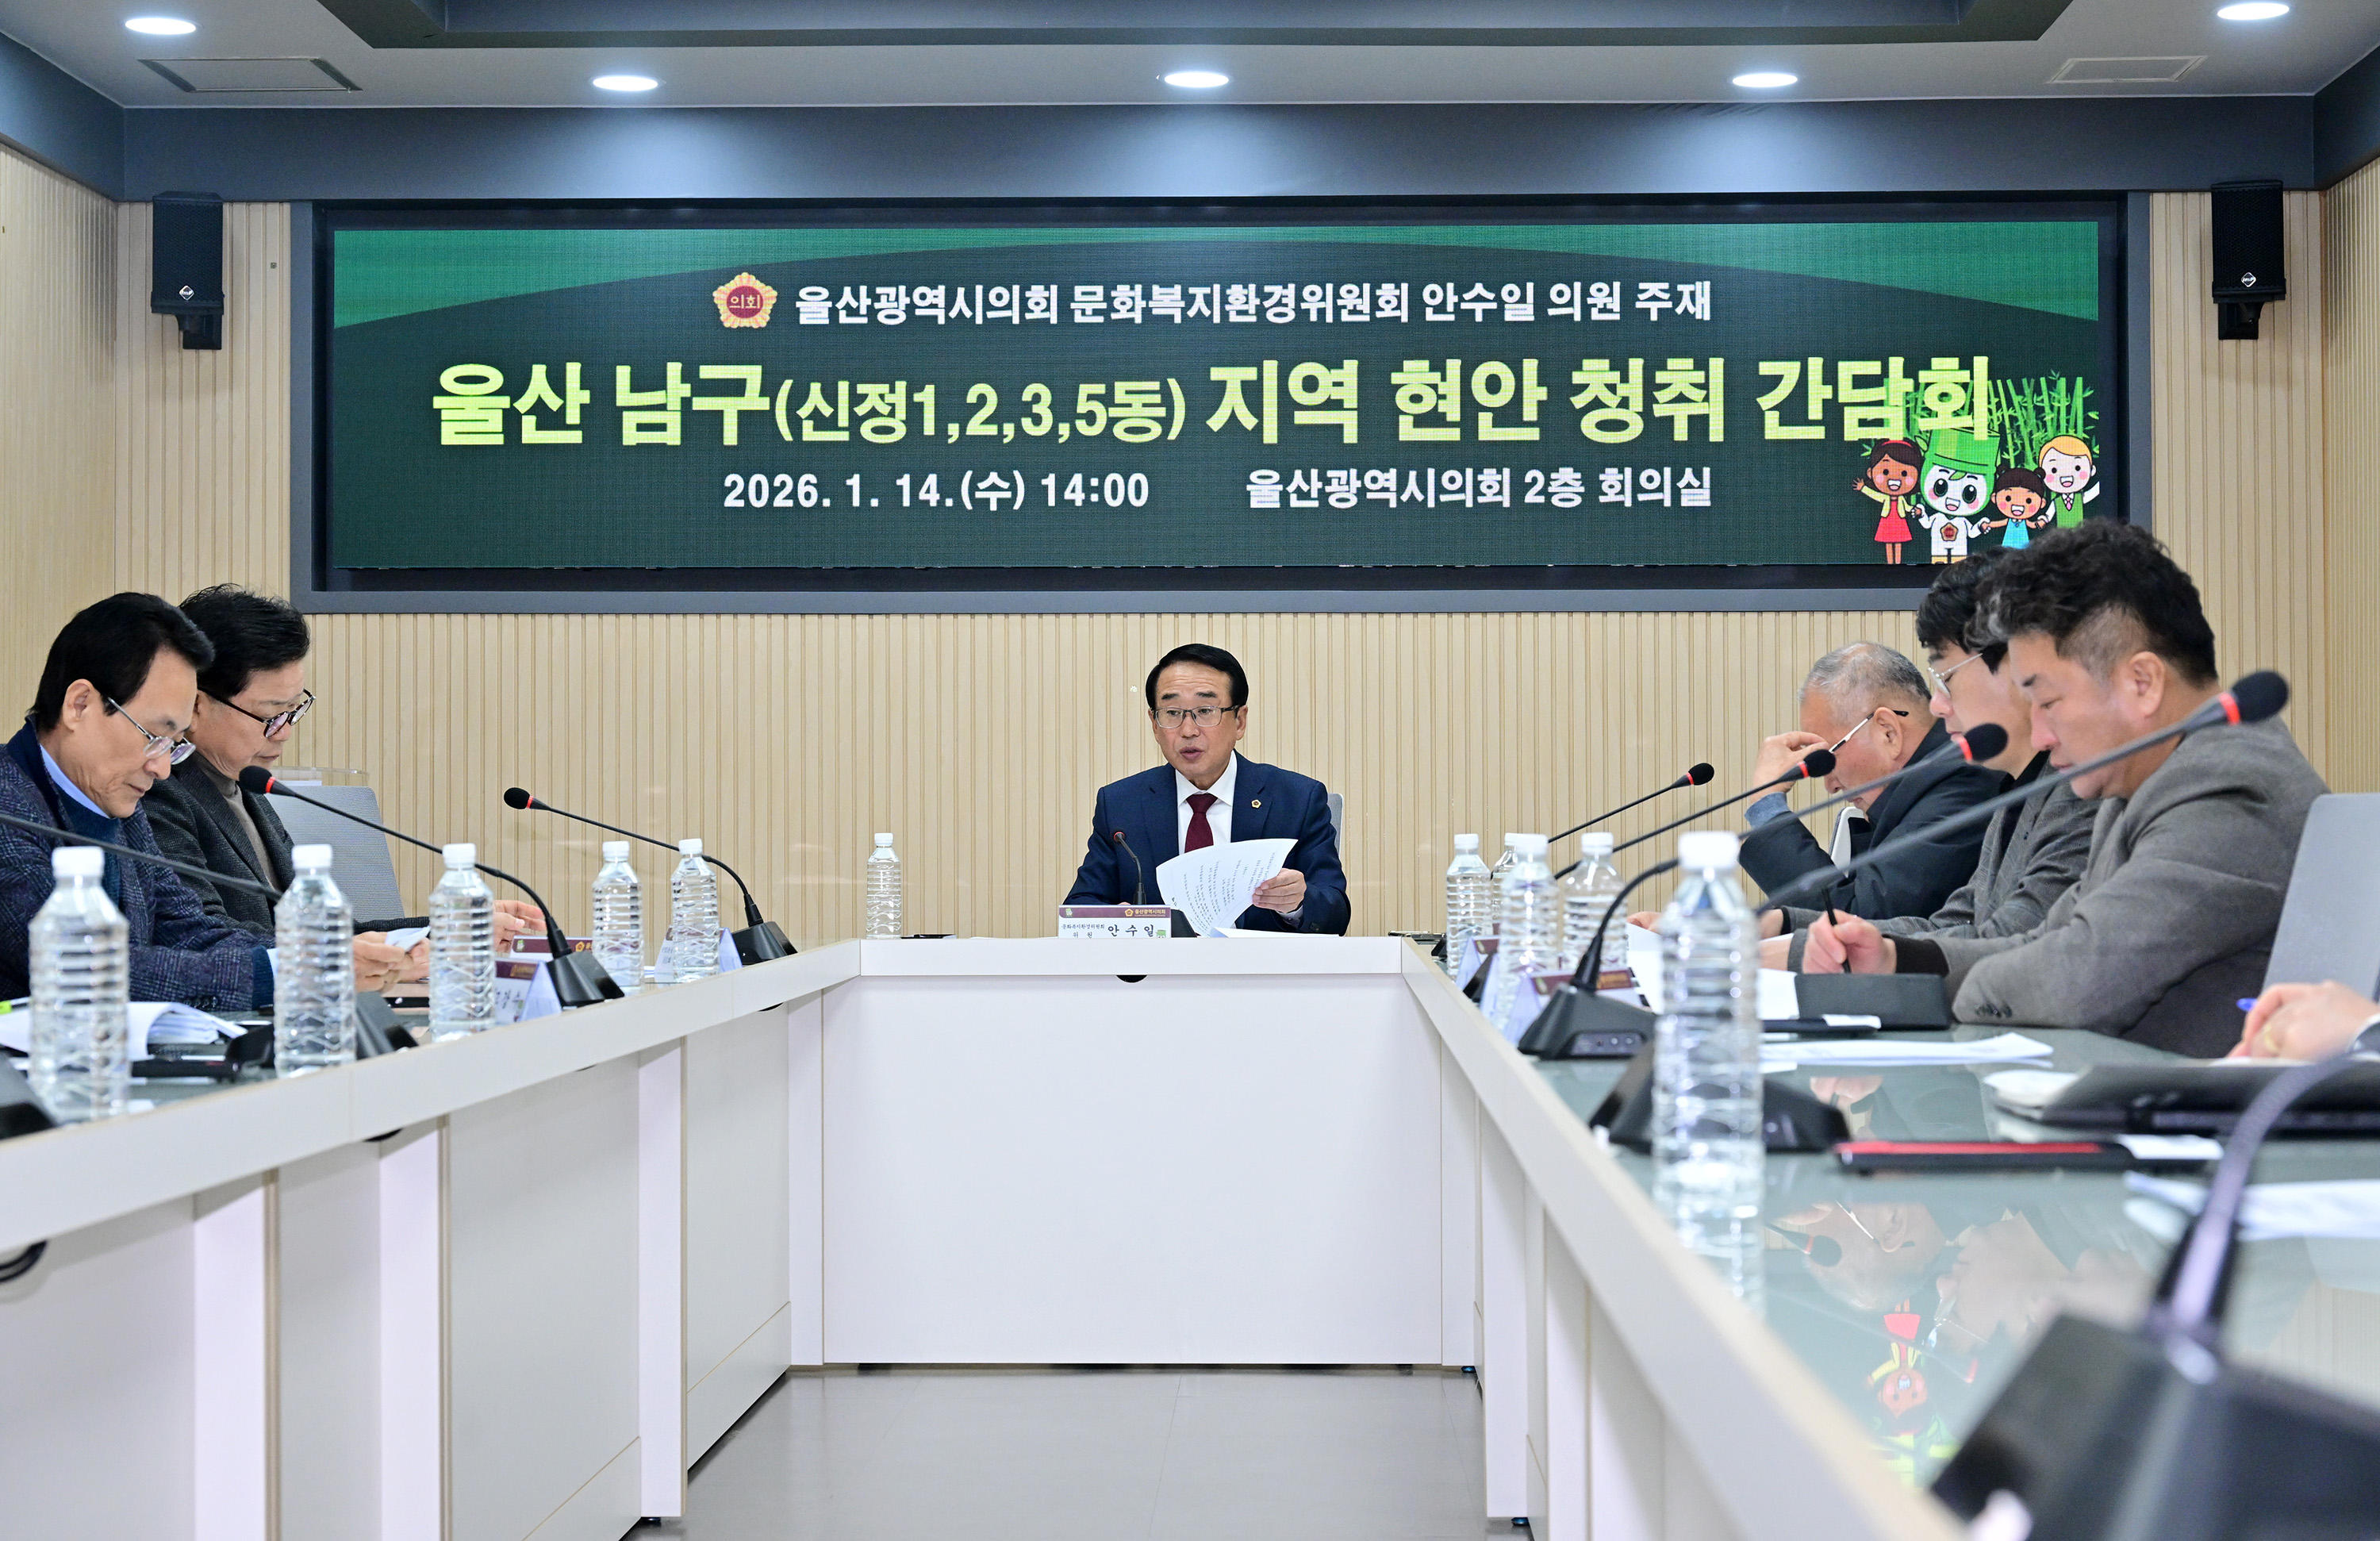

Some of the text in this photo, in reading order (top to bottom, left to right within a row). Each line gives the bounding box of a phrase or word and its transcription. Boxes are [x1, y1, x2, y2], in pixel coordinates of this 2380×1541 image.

[727, 293, 763, 310] 의회
[795, 280, 1711, 325] 울산광역시의회 문화복지환경위원회 안수일 의원 주재
[432, 362, 590, 445] 울산
[1206, 359, 1359, 444] 지역
[1391, 358, 1548, 441] 현안
[1569, 357, 1725, 444] 청취
[1756, 355, 1989, 441] 간담회
[724, 470, 1149, 511] 2026. 1. 14.(수) 14:00
[1246, 467, 1711, 509] 울산광역시의회 2층 회의실
